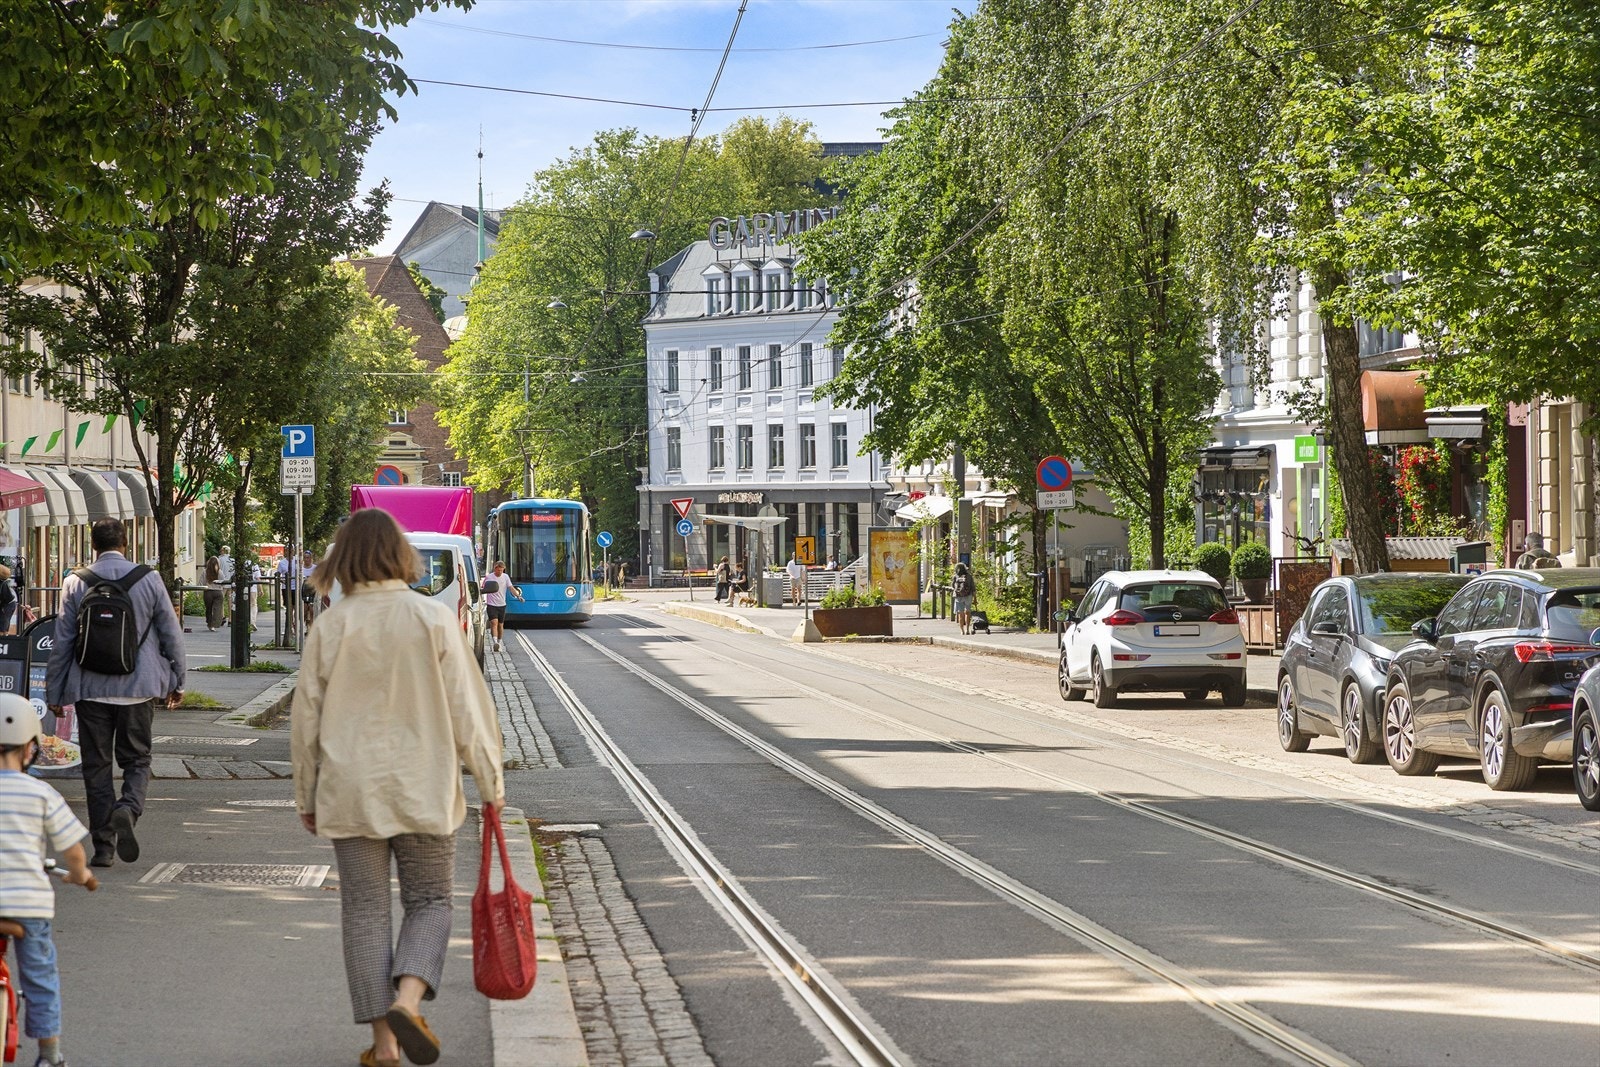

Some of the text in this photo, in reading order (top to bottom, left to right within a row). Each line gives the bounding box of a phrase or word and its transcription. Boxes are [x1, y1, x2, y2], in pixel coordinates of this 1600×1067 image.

[709, 207, 837, 251] GARMIN
[289, 430, 306, 454] P
[523, 514, 530, 522] 18
[801, 541, 809, 560] 1
